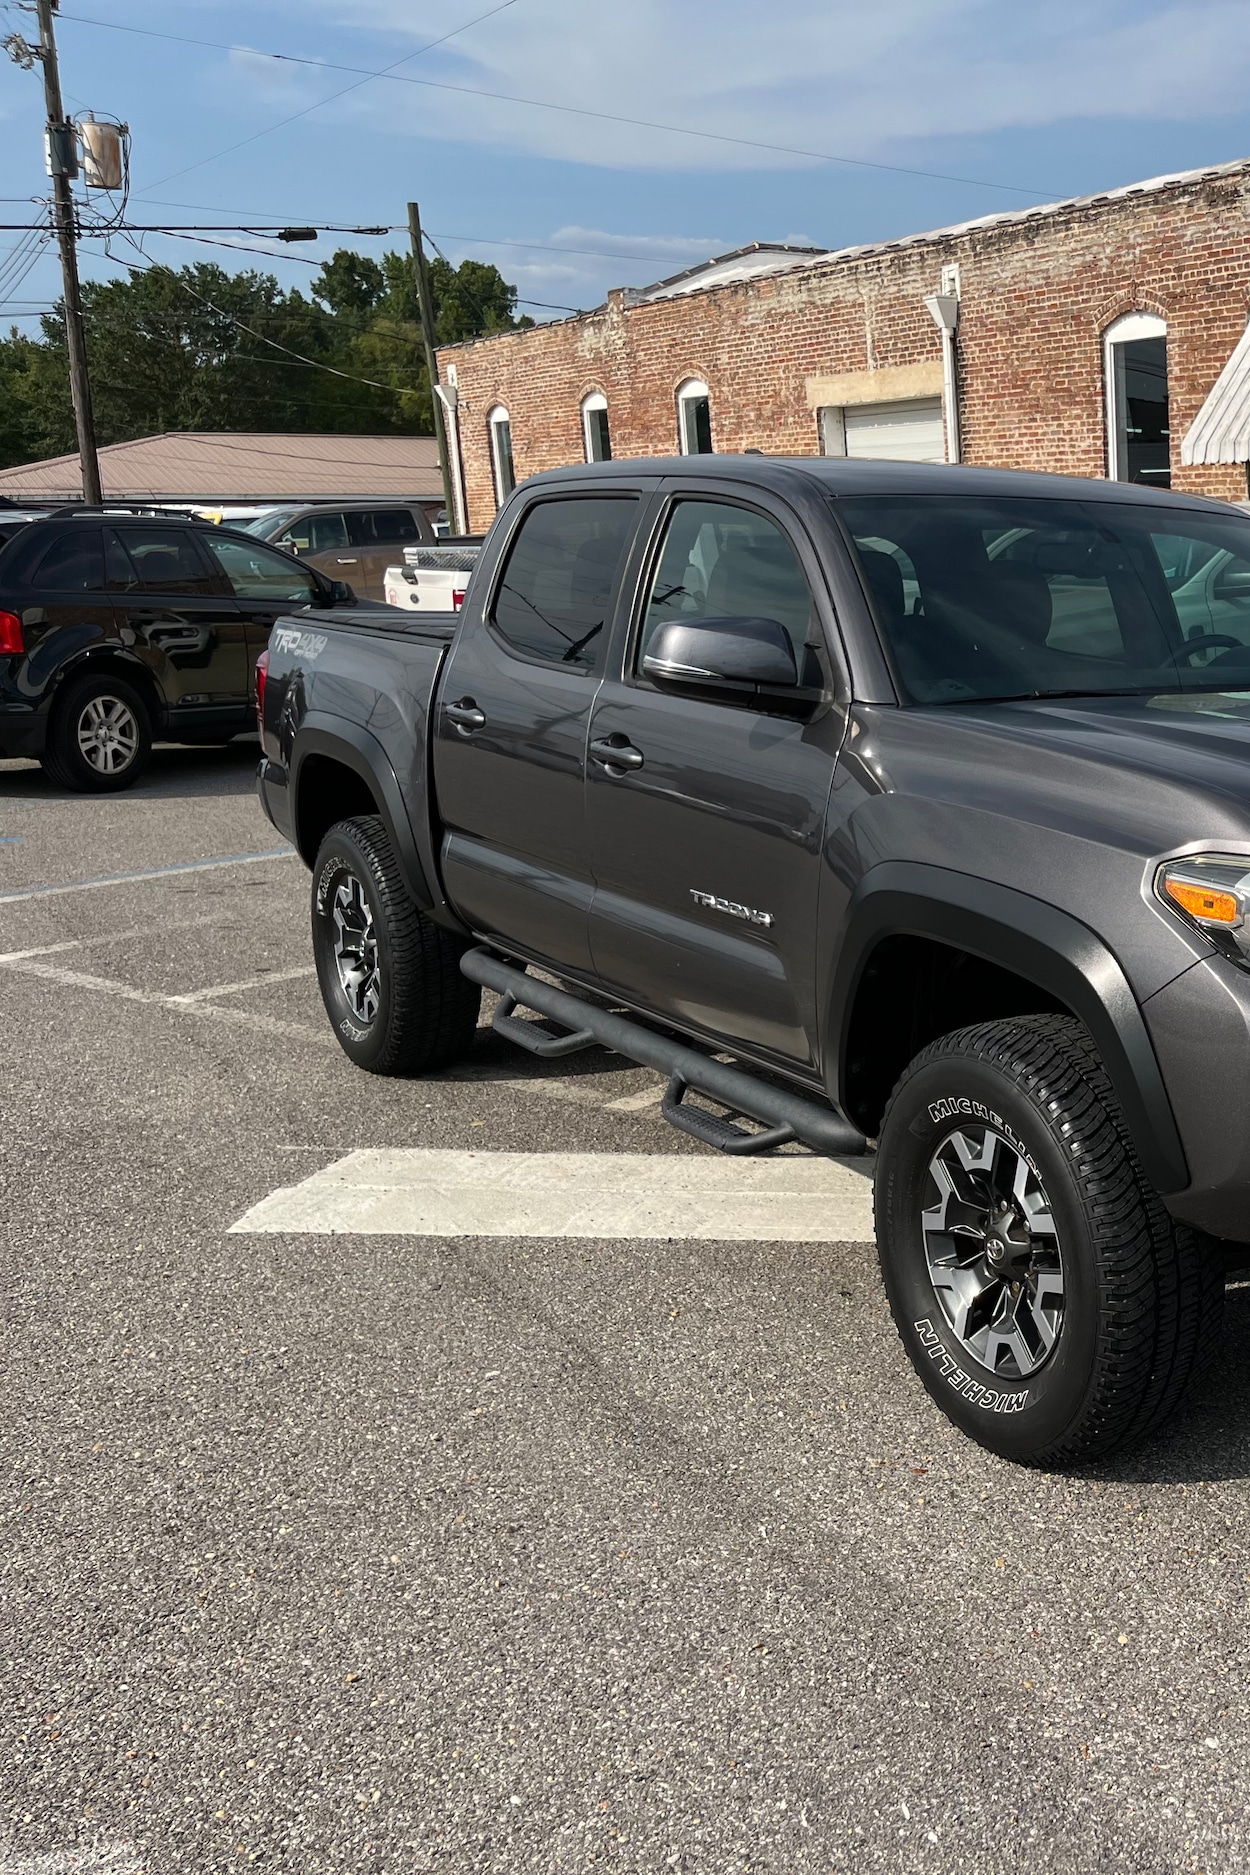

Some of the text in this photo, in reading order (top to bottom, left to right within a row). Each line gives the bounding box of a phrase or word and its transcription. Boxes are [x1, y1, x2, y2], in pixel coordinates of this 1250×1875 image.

[275, 628, 302, 653] TRD
[689, 888, 776, 928] TACOMA
[927, 1097, 1043, 1181] MICHELIN
[914, 1318, 1030, 1414] MICHELIN
